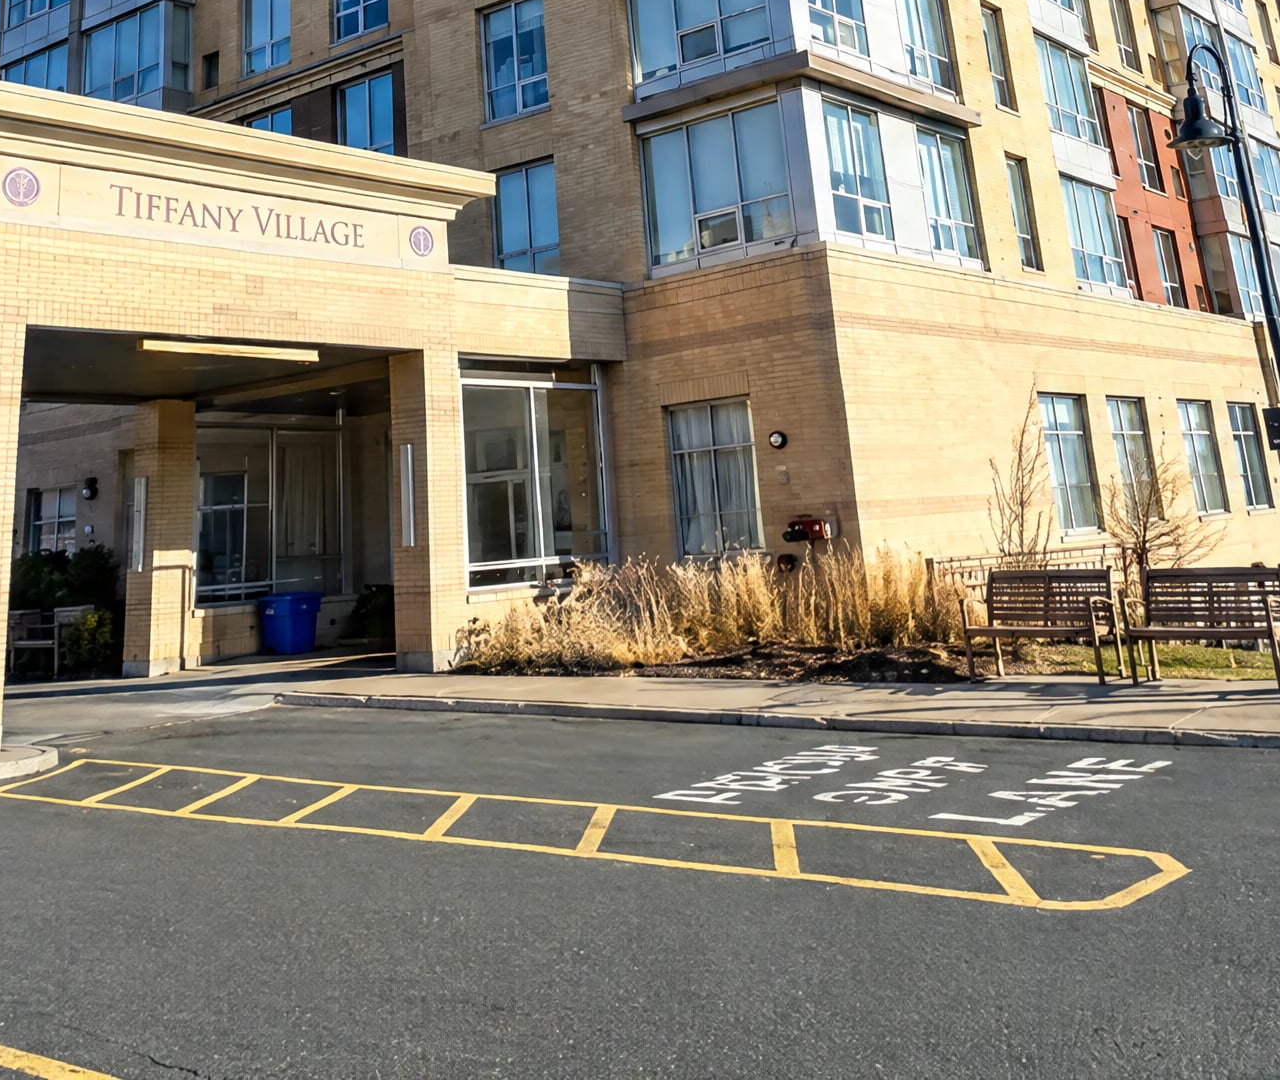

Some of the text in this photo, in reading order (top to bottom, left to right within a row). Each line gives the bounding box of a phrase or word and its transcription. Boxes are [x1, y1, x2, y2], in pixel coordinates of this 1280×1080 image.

[110, 184, 365, 249] TIFFANY VILLAGE
[928, 756, 1173, 826] LANE
